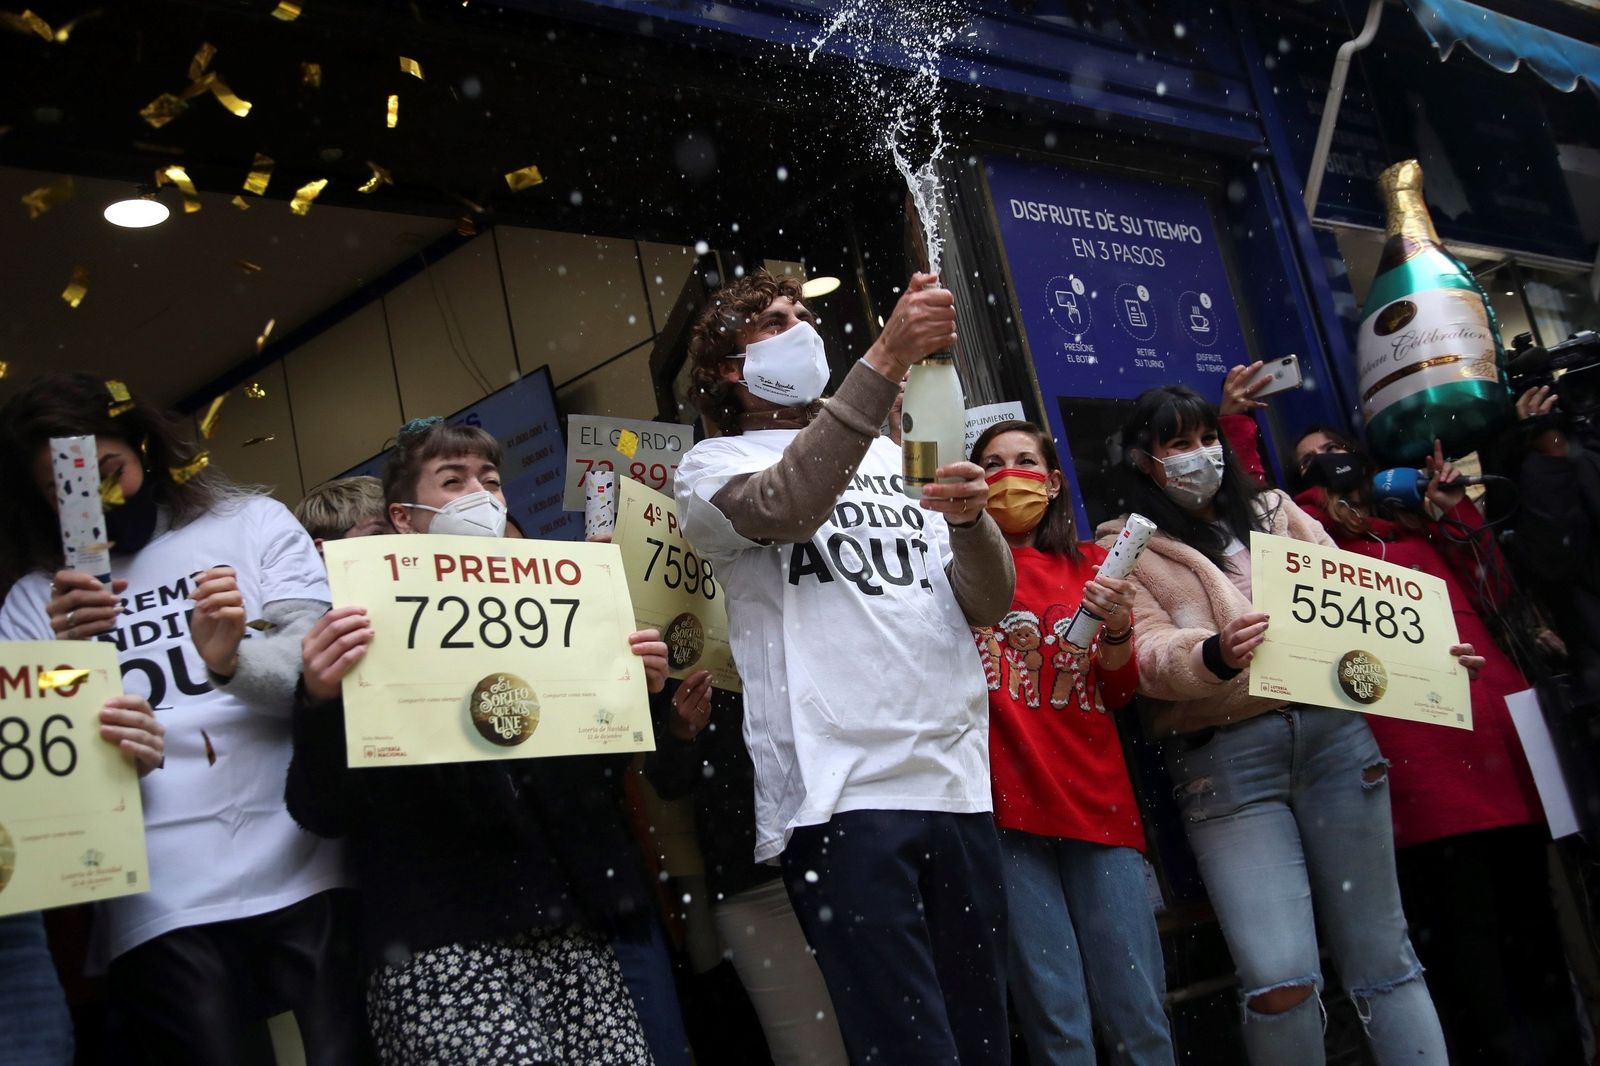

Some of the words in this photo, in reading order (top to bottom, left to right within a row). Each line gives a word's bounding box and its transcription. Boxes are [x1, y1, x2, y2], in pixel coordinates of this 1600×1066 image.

[1010, 199, 1094, 229] DISFRUTE
[1096, 213, 1117, 232] DE
[1120, 215, 1142, 235] SU
[1144, 219, 1202, 244] TIEMPO
[1072, 238, 1096, 258] EN
[1098, 241, 1110, 260] 3
[1112, 243, 1166, 267] PASOS
[1064, 342, 1095, 353] PRESIONE
[1067, 354, 1076, 363] EL
[1136, 347, 1157, 357] RETIRE
[1134, 359, 1144, 368] SU
[1144, 359, 1165, 369] TURNO
[965, 412, 1015, 429] MPLIMIENTO
[580, 426, 603, 446] EL
[609, 429, 682, 452] GRDO
[964, 431, 975, 440] AS
[845, 473, 903, 497] MIO
[829, 501, 924, 531] DIDO
[434, 553, 582, 585] PREMIO
[643, 537, 716, 600] 7598
[1321, 558, 1423, 600] PREMIO
[119, 571, 205, 616] REM
[395, 595, 580, 650] 72897
[1291, 584, 1425, 644] 55483
[0, 664, 81, 699] MIO
[120, 645, 215, 711] QU
[479, 687, 529, 714] SORTEO
[488, 715, 522, 740] UNE
[0, 714, 78, 781] 86
